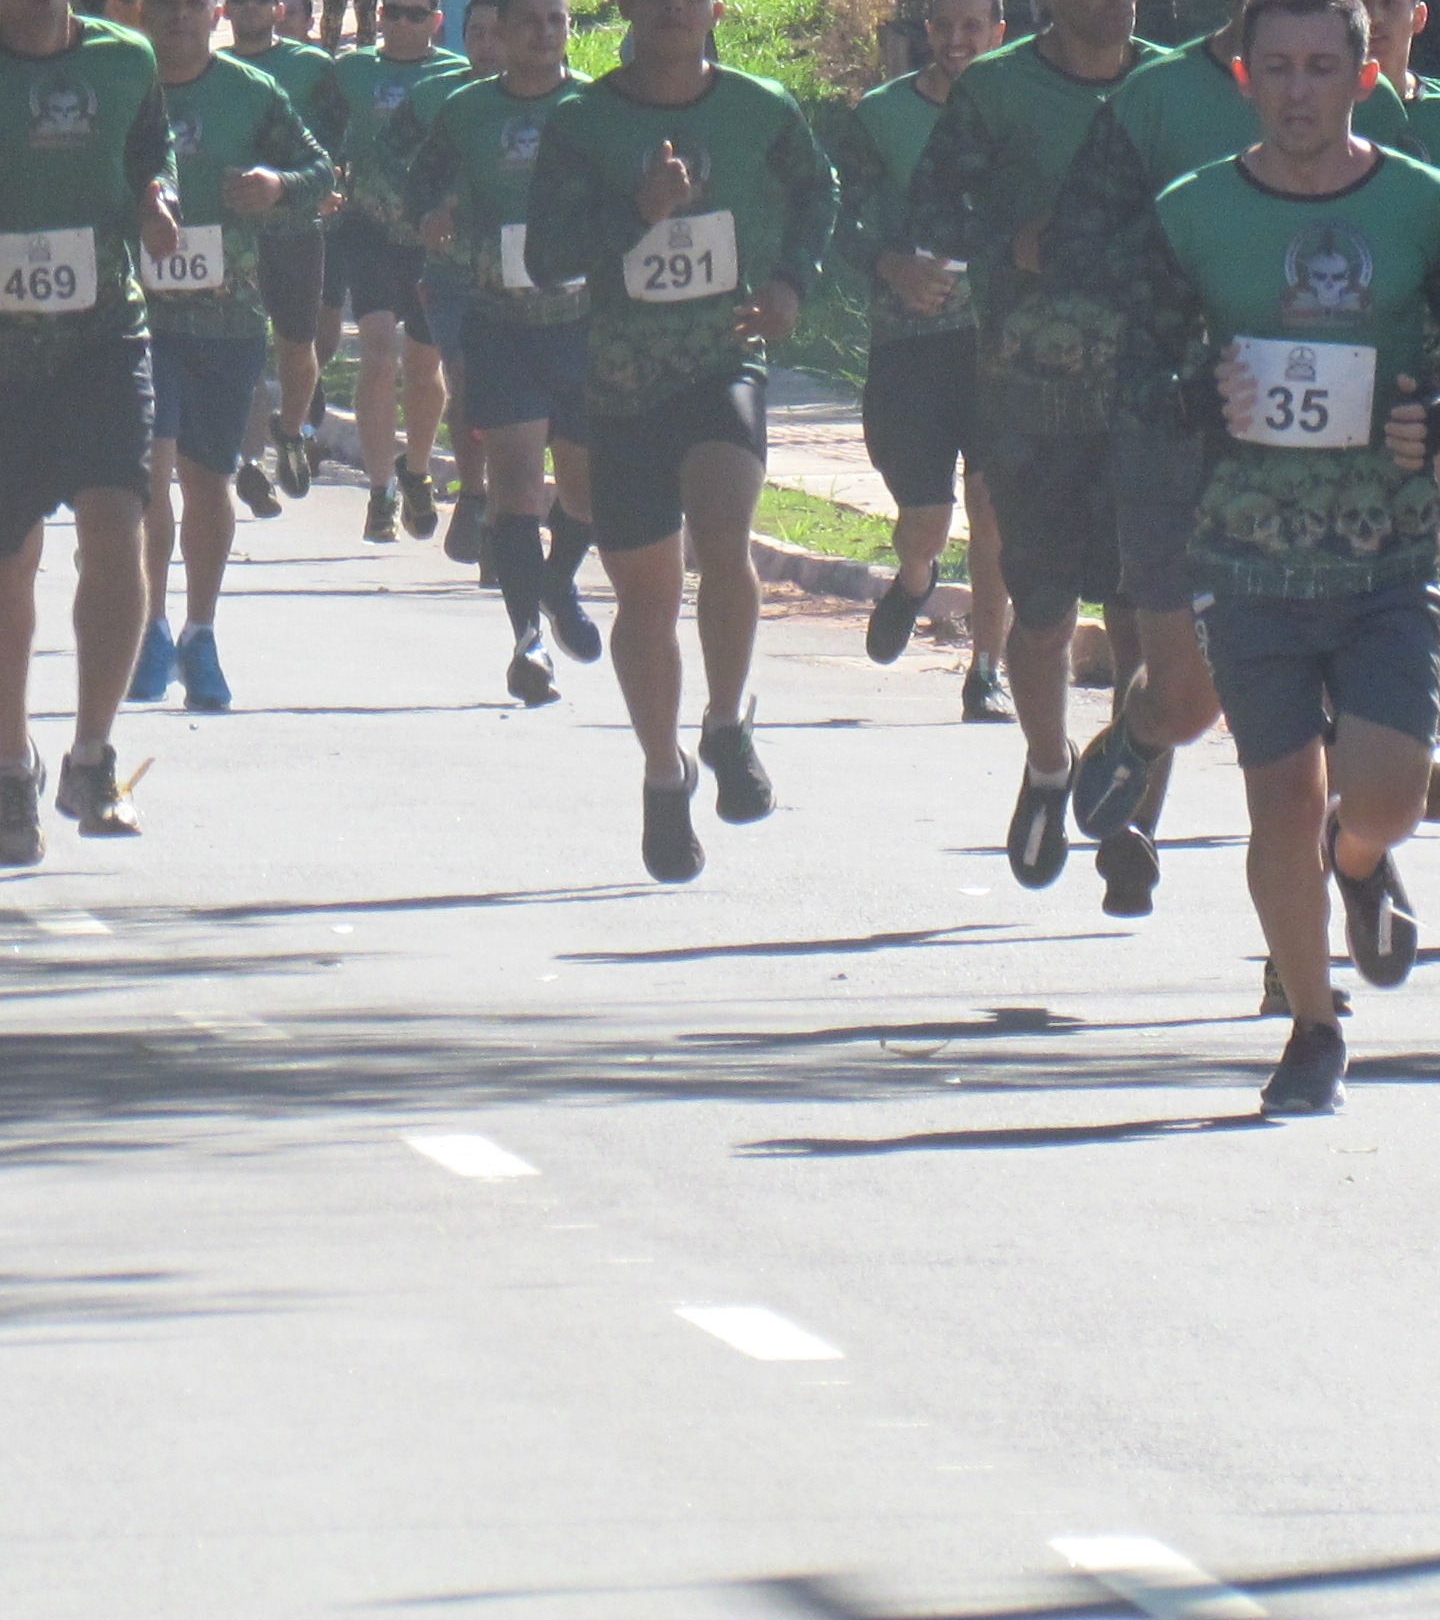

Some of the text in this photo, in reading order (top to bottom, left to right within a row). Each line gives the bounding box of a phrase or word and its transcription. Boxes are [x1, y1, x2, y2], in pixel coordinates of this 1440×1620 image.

[4, 266, 78, 301] 469
[151, 253, 208, 281] 106
[642, 249, 716, 292] 291
[1265, 385, 1329, 433] 35
